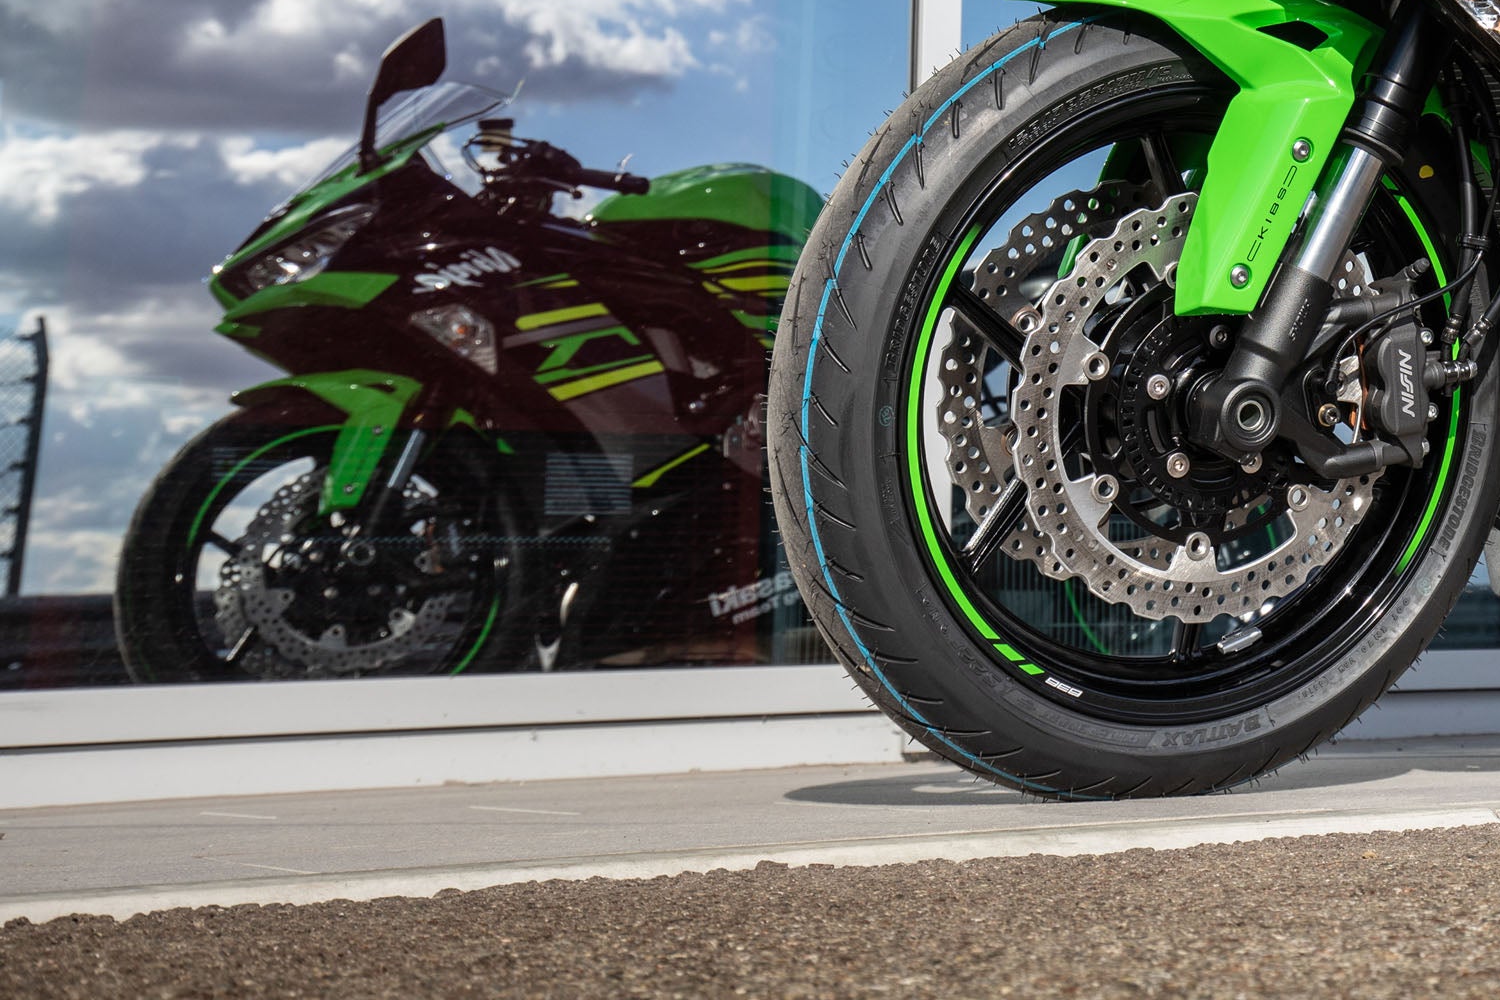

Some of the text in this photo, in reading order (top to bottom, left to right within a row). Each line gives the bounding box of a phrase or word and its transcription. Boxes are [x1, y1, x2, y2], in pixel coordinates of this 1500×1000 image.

[1398, 349, 1416, 418] NISSIN
[1438, 429, 1487, 552] BRIDGESTONE
[1161, 713, 1262, 747] BATTLAX
